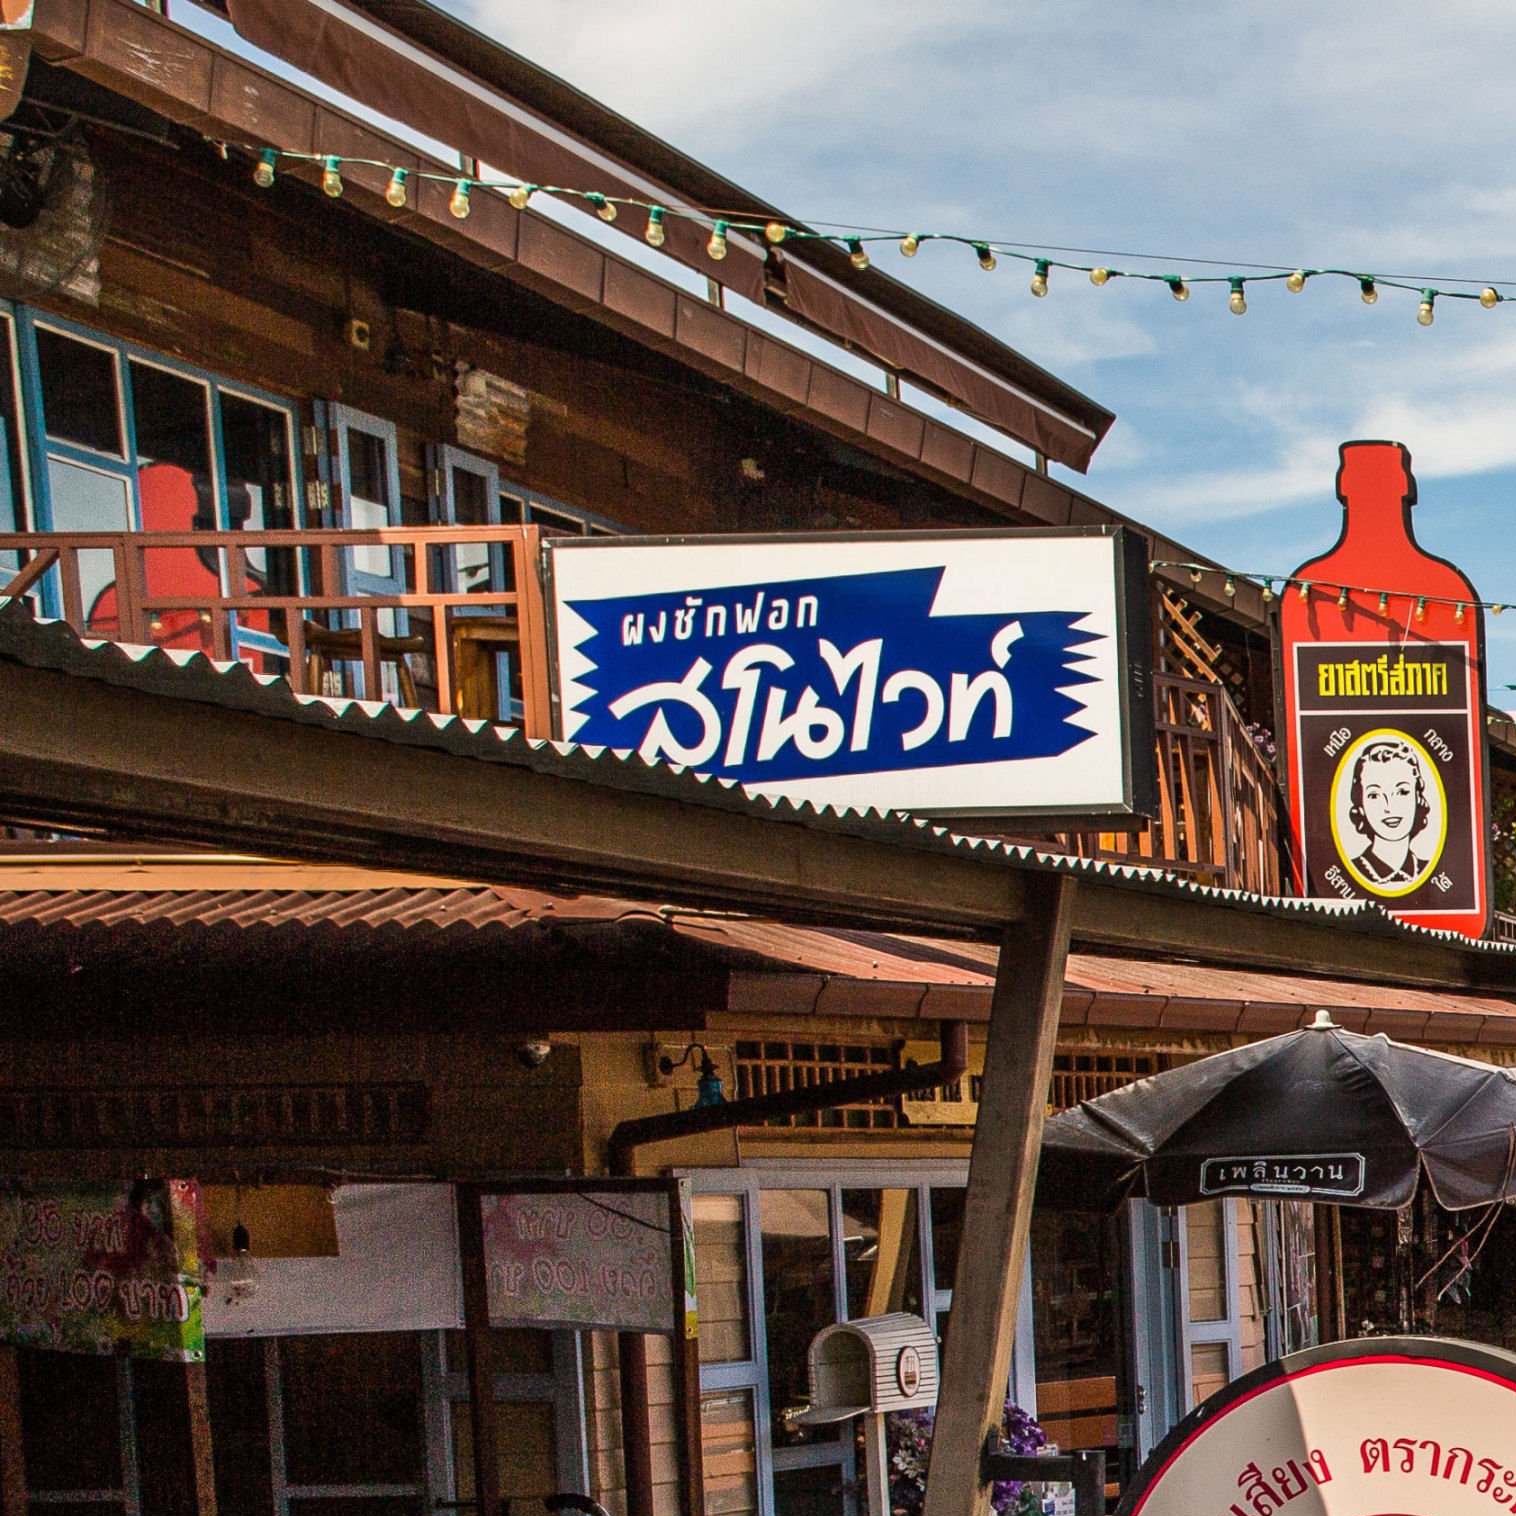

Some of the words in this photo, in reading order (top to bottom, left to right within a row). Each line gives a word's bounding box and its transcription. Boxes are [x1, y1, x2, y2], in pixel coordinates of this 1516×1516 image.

[621, 591, 819, 647] ผงซักฟอก
[1317, 653, 1448, 697] ยาสตรีสี่ภาค
[607, 620, 1025, 767] สโนไวท์
[1323, 727, 1352, 758] เหนือ
[1422, 728, 1455, 763] กลาง
[1323, 864, 1357, 900] อีสาน
[1430, 871, 1454, 893] ใต้
[1219, 1160, 1344, 1181] เพลินวาน
